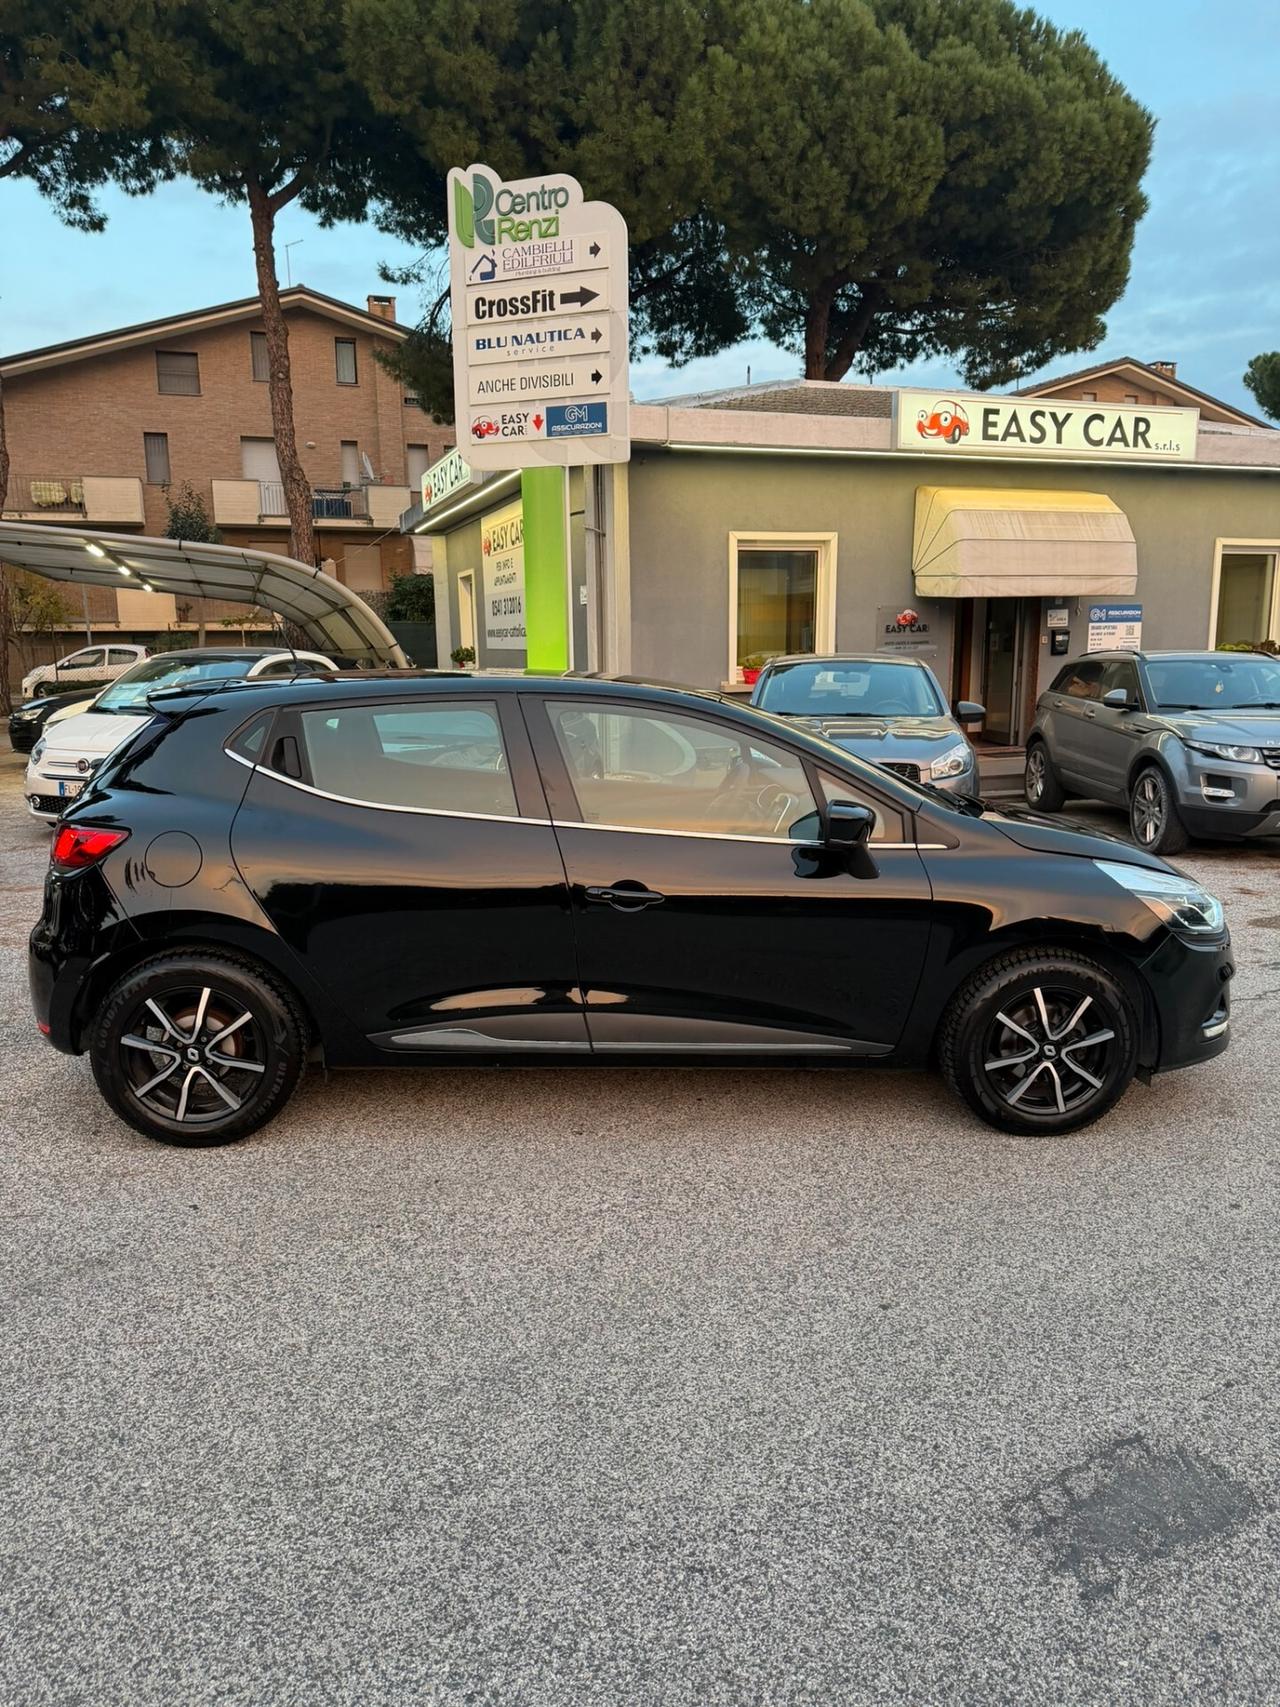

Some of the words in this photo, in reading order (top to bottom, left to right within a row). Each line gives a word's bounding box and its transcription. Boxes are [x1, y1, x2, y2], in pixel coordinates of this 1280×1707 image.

[495, 184, 569, 216] Centro
[497, 209, 560, 244] Renzi
[502, 239, 573, 259] CAMBIELLI
[502, 251, 574, 271] EDILFRIULI
[474, 289, 556, 319] CrossFit
[476, 336, 508, 350] BLU
[511, 327, 586, 347] NAUTICA
[506, 345, 555, 357] service
[477, 377, 517, 394] ANCHE
[520, 372, 574, 391] DIVISIBILI
[501, 412, 530, 425] EASY
[564, 405, 588, 423] GM
[501, 425, 525, 437] CAR
[551, 422, 603, 432] ASSICURAZIONI
[982, 407, 1073, 444] EASY
[1083, 413, 1152, 448] CAR
[433, 464, 449, 498] EASY
[492, 524, 509, 552] EASY
[885, 624, 907, 633] EASY
[909, 624, 928, 633] CAR
